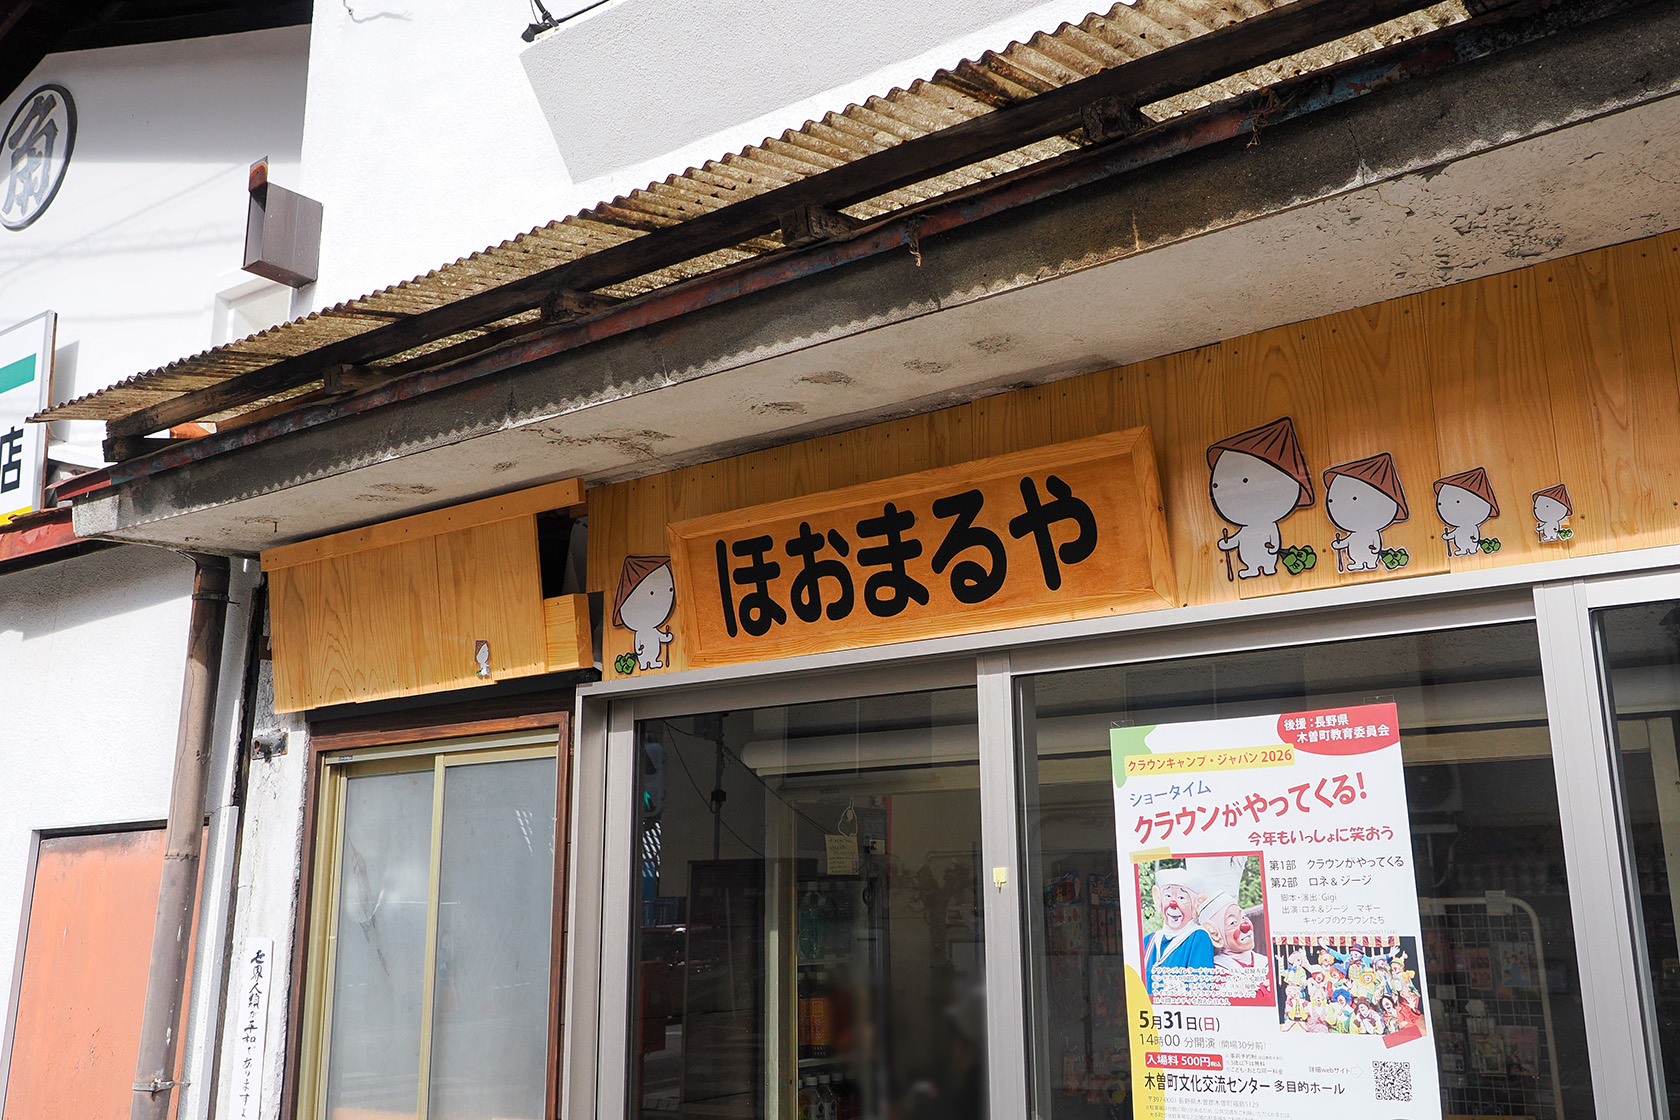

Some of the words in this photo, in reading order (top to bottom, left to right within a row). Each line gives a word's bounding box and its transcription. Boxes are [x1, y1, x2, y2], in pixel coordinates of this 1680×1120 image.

[716, 475, 1097, 637] ほおまるや
[1284, 714, 1349, 731] 後援：長野県
[1296, 724, 1390, 743] 木曽町教育委員会
[1261, 749, 1292, 763] 2026
[1130, 780, 1211, 807] ショータイム
[1248, 826, 1393, 846] 今年もいっしょに笑おう
[1269, 860, 1297, 871] 第1部
[1307, 856, 1404, 870] クラウンがやってくる
[1270, 877, 1298, 888] 第2部
[1146, 1054, 1179, 1066] 入場料
[1144, 1072, 1270, 1094] 木曽町文化交流センター
[1274, 1080, 1345, 1095] 多目的ホール
